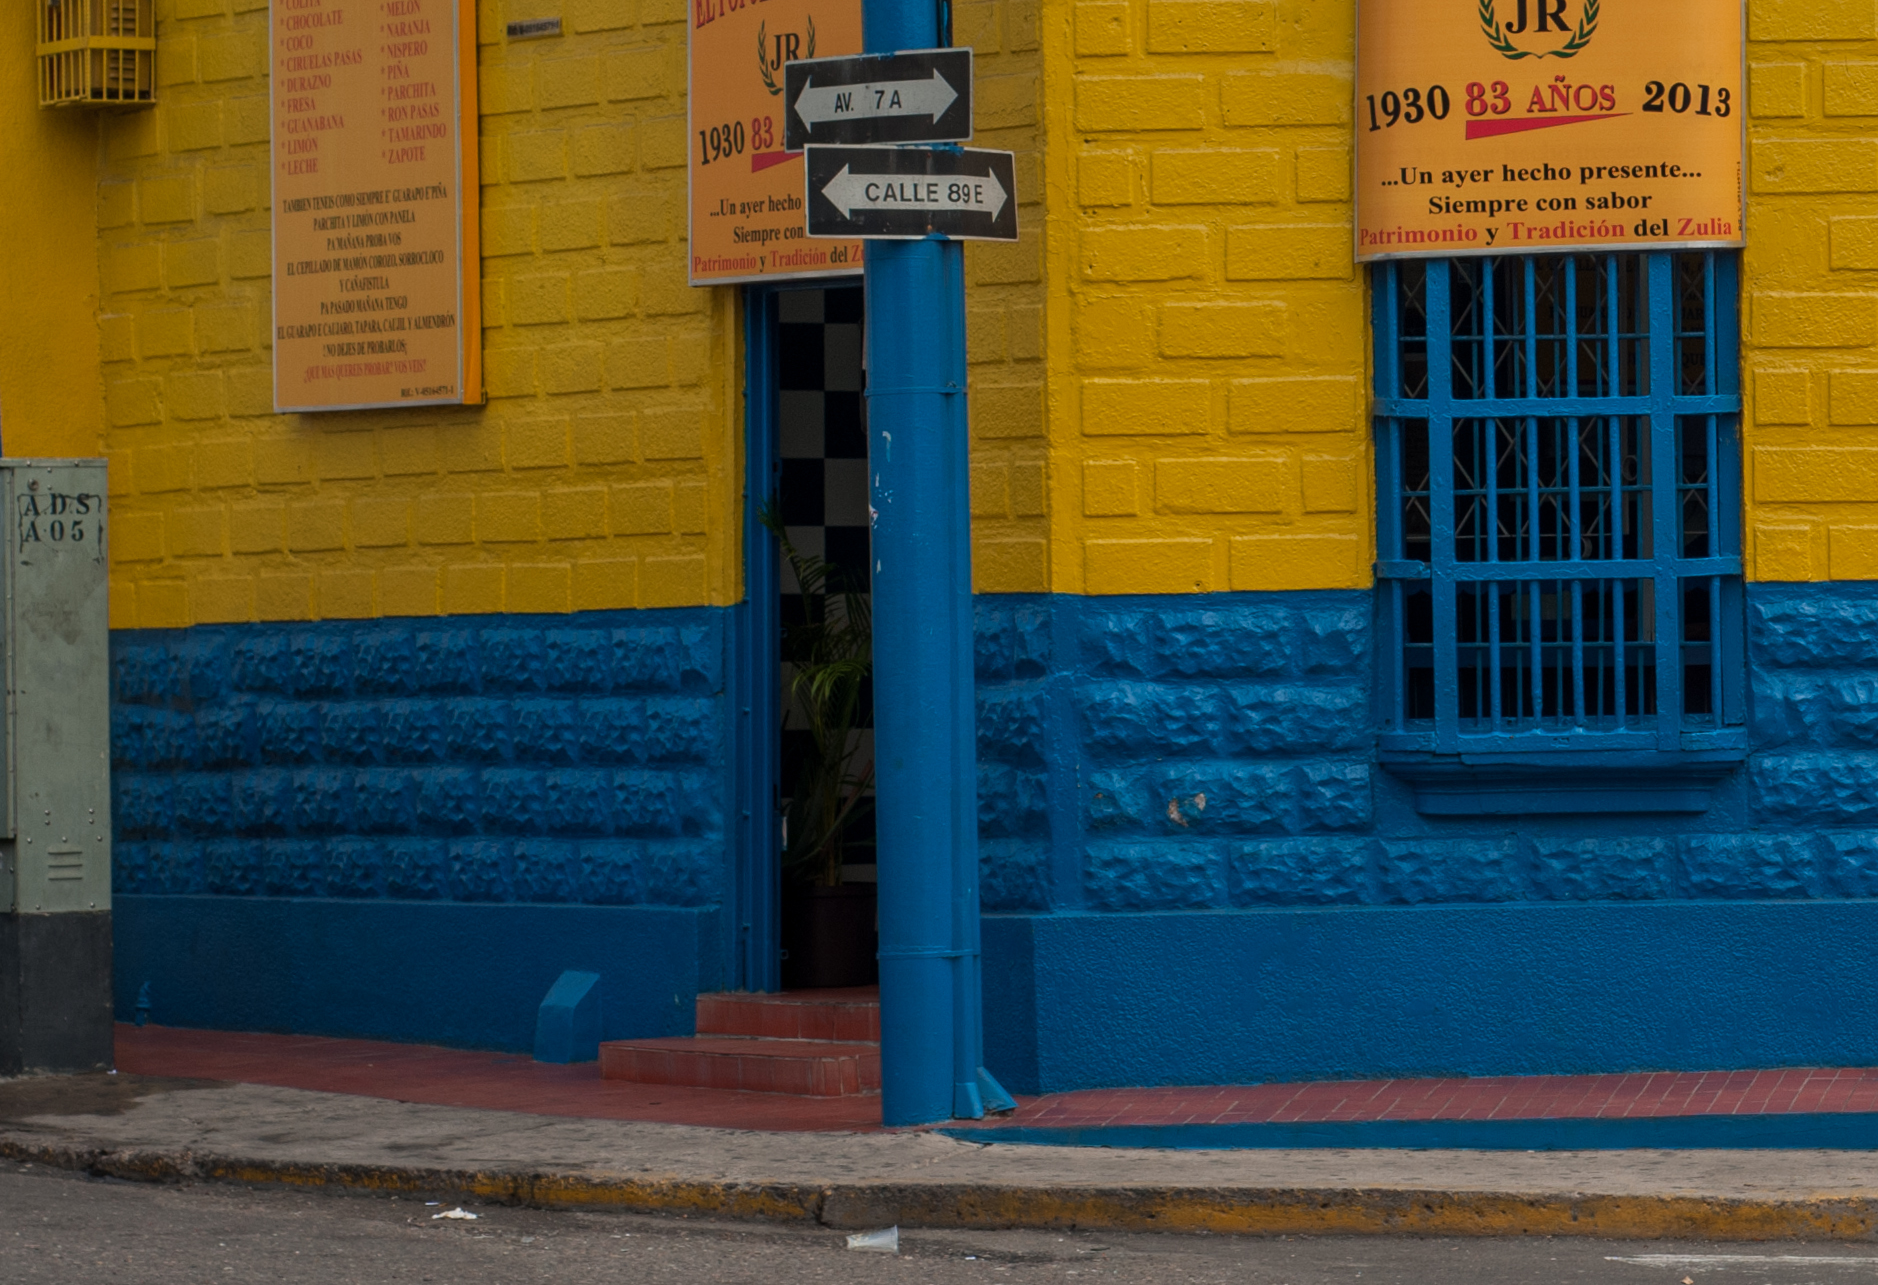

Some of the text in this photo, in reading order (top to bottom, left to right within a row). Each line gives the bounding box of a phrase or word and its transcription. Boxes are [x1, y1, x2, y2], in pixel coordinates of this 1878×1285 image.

[772, 32, 800, 71] JR
[834, 92, 854, 114] AV.
[1366, 75, 1731, 132] 1930 83 AÑOS 2013
[699, 116, 774, 165] 1930 83
[1441, 169, 1494, 189] ayer
[1501, 163, 1571, 182] hecho
[865, 182, 939, 203] CALLE
[1428, 192, 1652, 217] Siempre con sabor
[740, 198, 765, 219] ayer
[768, 193, 801, 213] hecho
[733, 225, 804, 246] Siempre con
[1359, 217, 1732, 247] Patrimonio y Tradición del Zulia
[693, 250, 756, 273] Patrimonio
[760, 257, 767, 272] y
[770, 247, 827, 267] Tradición
[830, 245, 848, 263] del
